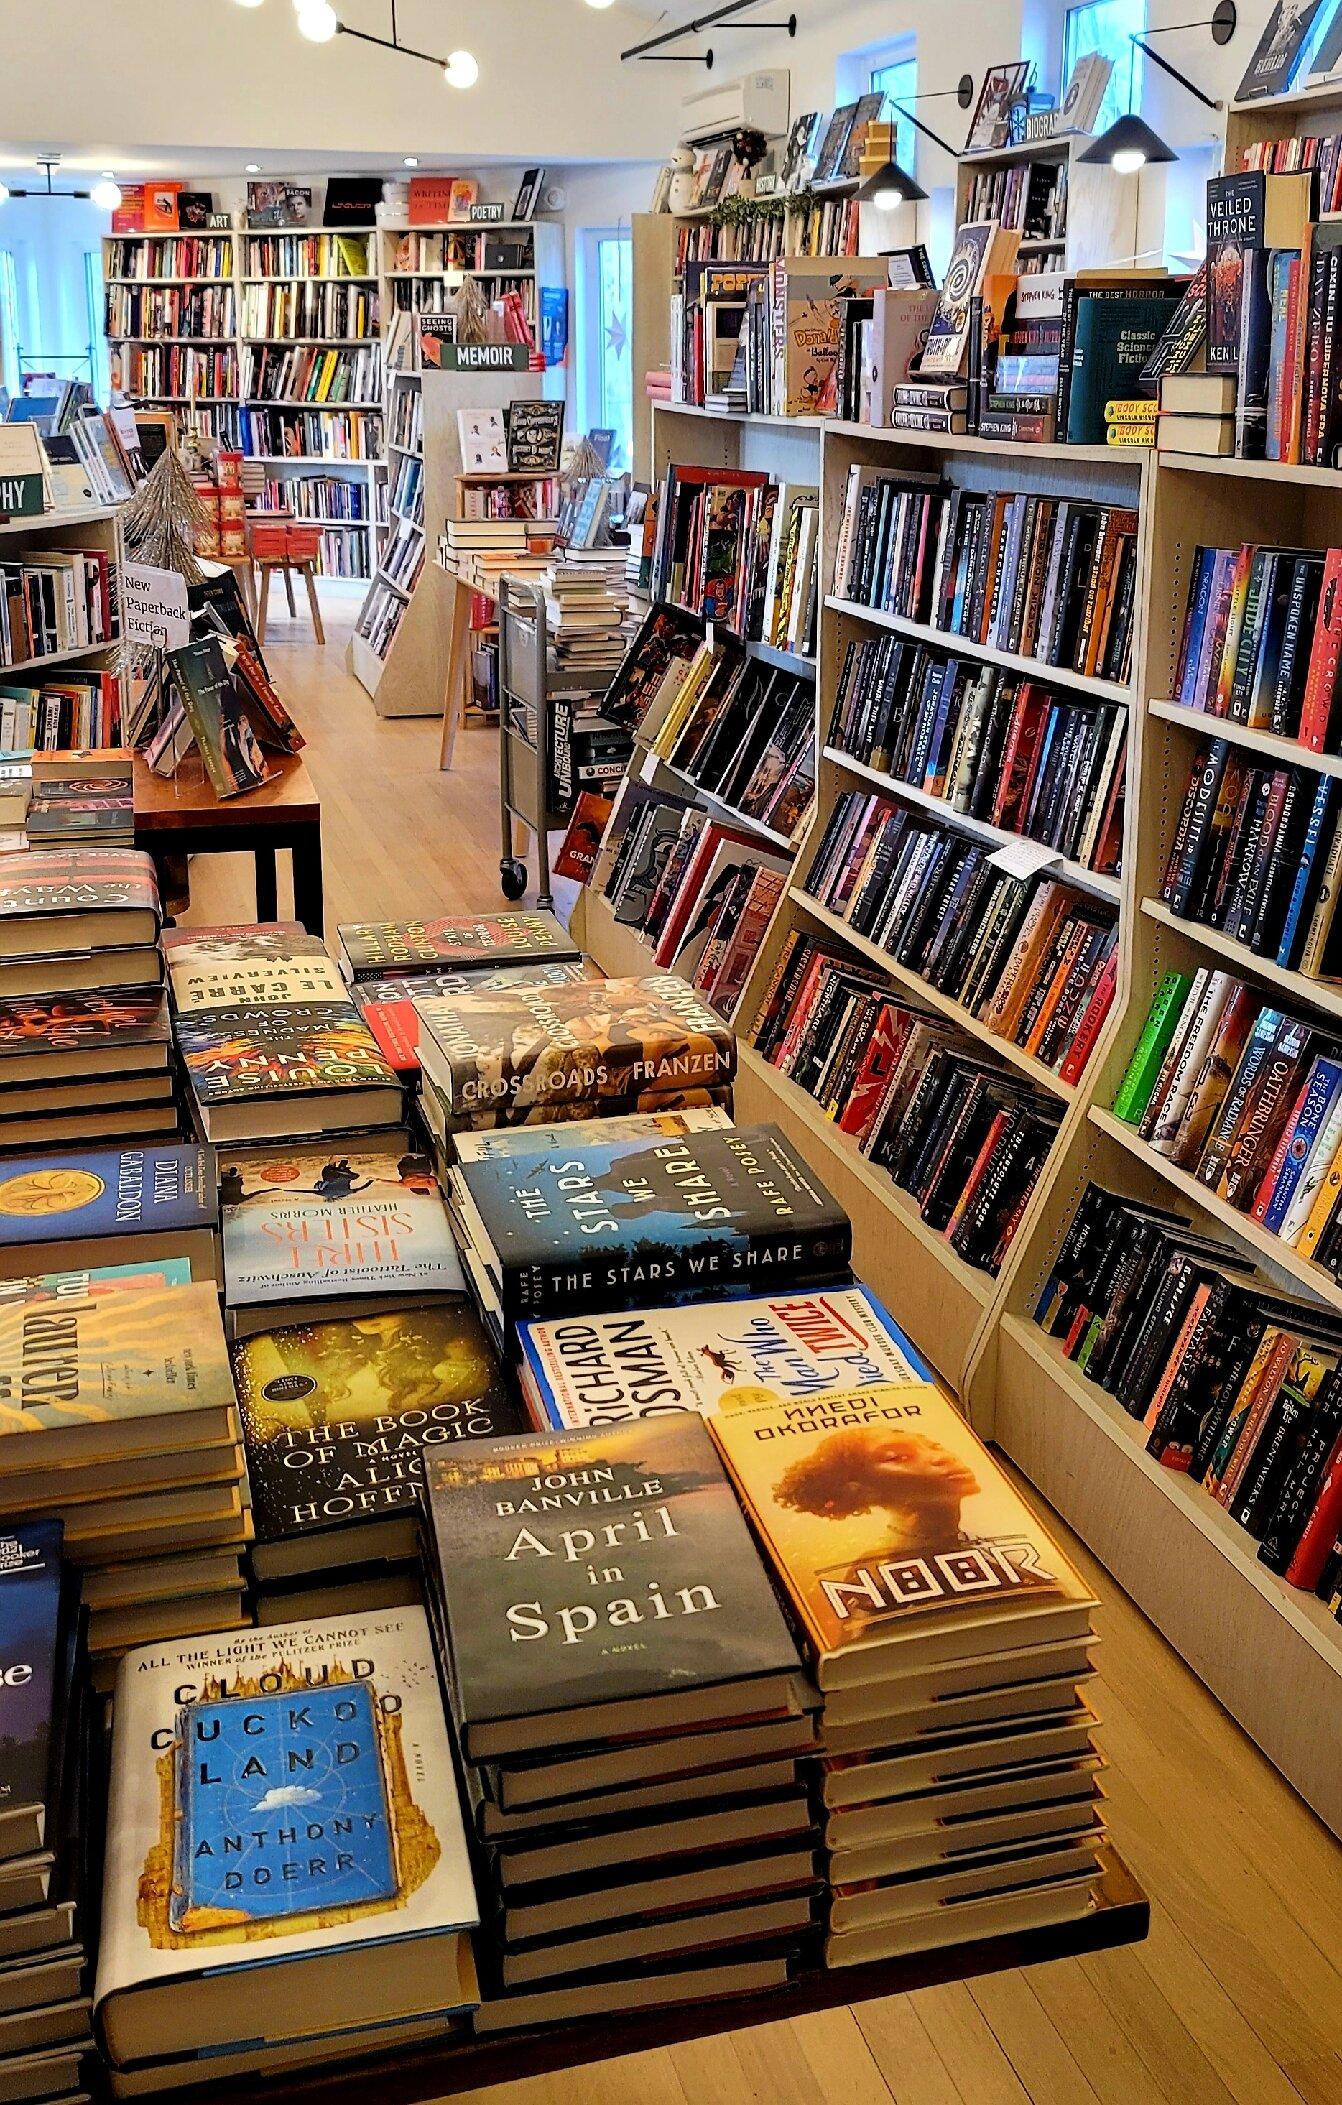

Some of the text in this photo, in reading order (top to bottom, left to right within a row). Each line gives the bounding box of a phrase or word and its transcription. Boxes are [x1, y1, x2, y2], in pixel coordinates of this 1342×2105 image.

[1026, 114, 1059, 139] BIOGRA
[209, 216, 228, 229] ART
[472, 205, 502, 219] POETRY
[1210, 197, 1252, 218] VEILED
[1208, 216, 1256, 237] THRONE
[1328, 256, 1338, 300] CIXIN
[421, 317, 452, 326] SEEING
[1120, 331, 1156, 341] Classic
[1325, 306, 1334, 332] LIU
[457, 346, 513, 366] MEMOIR
[1119, 353, 1149, 364] Fictio
[1210, 347, 1229, 362] KEN
[1319, 336, 1332, 411] SUPERNOVA
[125, 576, 151, 592] New
[126, 597, 186, 620] Paperback
[1279, 576, 1306, 679] UNSPOKEN NAME
[553, 704, 570, 784] ARCHITECTURE
[560, 742, 573, 798] UNBOUND
[598, 765, 626, 775] CONCI
[354, 924, 385, 964] HILLARY
[388, 921, 412, 963] RODHAM
[412, 919, 438, 961] CLINTON
[496, 917, 532, 949] LOUISE
[521, 916, 558, 947] PENNY
[188, 967, 326, 985] SILVERVIEW
[190, 979, 335, 1003] LE CARRÉ
[200, 1007, 335, 1024] CROWDS
[240, 993, 288, 1004] JOHN
[259, 1019, 288, 1028] OF
[522, 993, 580, 1049] CROSSROAD
[207, 1048, 370, 1072] PENNY
[633, 1052, 730, 1080] FRANZEN
[1160, 990, 1214, 1122] THE FREEDOM RACE
[206, 1063, 384, 1089] LOUISE
[461, 1065, 608, 1100] CROSSROADS
[1214, 1045, 1266, 1153] WORDS RADIANCE
[1235, 1059, 1288, 1168] OATHBRINGER
[1299, 1072, 1326, 1128] SEASON
[1308, 1092, 1327, 1130] BONE
[723, 1136, 766, 1174] POSEY
[115, 1151, 144, 1222] GABALDON
[153, 1160, 178, 1204] DIANA
[549, 1160, 619, 1235] STARS
[623, 1177, 658, 1204] WE
[655, 1144, 732, 1222] SHARE
[756, 1180, 794, 1217] RAFE
[270, 1202, 398, 1219] HEATHER MORRIS
[515, 1187, 552, 1222] THE
[261, 1212, 414, 1243] SISTERS
[552, 1244, 803, 1292] THE STARS WE SHARE
[520, 1272, 530, 1304] RAFE
[768, 1301, 858, 1354] TWICE
[1183, 1306, 1212, 1372] FANTASY
[781, 1357, 840, 1396] Man
[280, 1397, 490, 1448] THE BOOK
[754, 1404, 923, 1441] OKORAFOR
[783, 1396, 881, 1422] NNEDI
[283, 1417, 495, 1469] OF MAGIC
[337, 1457, 422, 1492] ALIC
[531, 1468, 615, 1492] JOHN
[1248, 1425, 1286, 1506] BRENT WEEKS
[291, 1482, 422, 1524] HOFF
[495, 1479, 664, 1517] BANVILLE
[504, 1506, 680, 1563] April
[587, 1564, 625, 1585] in
[820, 1544, 1058, 1619] NOOR
[506, 1582, 722, 1645] Spain
[138, 1622, 405, 1673] ALL THE LIGHT WE CANNOT SEE
[186, 1658, 232, 1671] WINNER
[271, 1645, 325, 1660] PULITZER
[330, 1640, 360, 1651] PRIZE
[174, 1657, 375, 1706] CLOUD
[151, 1693, 403, 1751] CUCKOO
[200, 1741, 360, 1786] LAND
[194, 1813, 378, 1859] ANTHONY
[225, 1852, 355, 1890] DOERR
